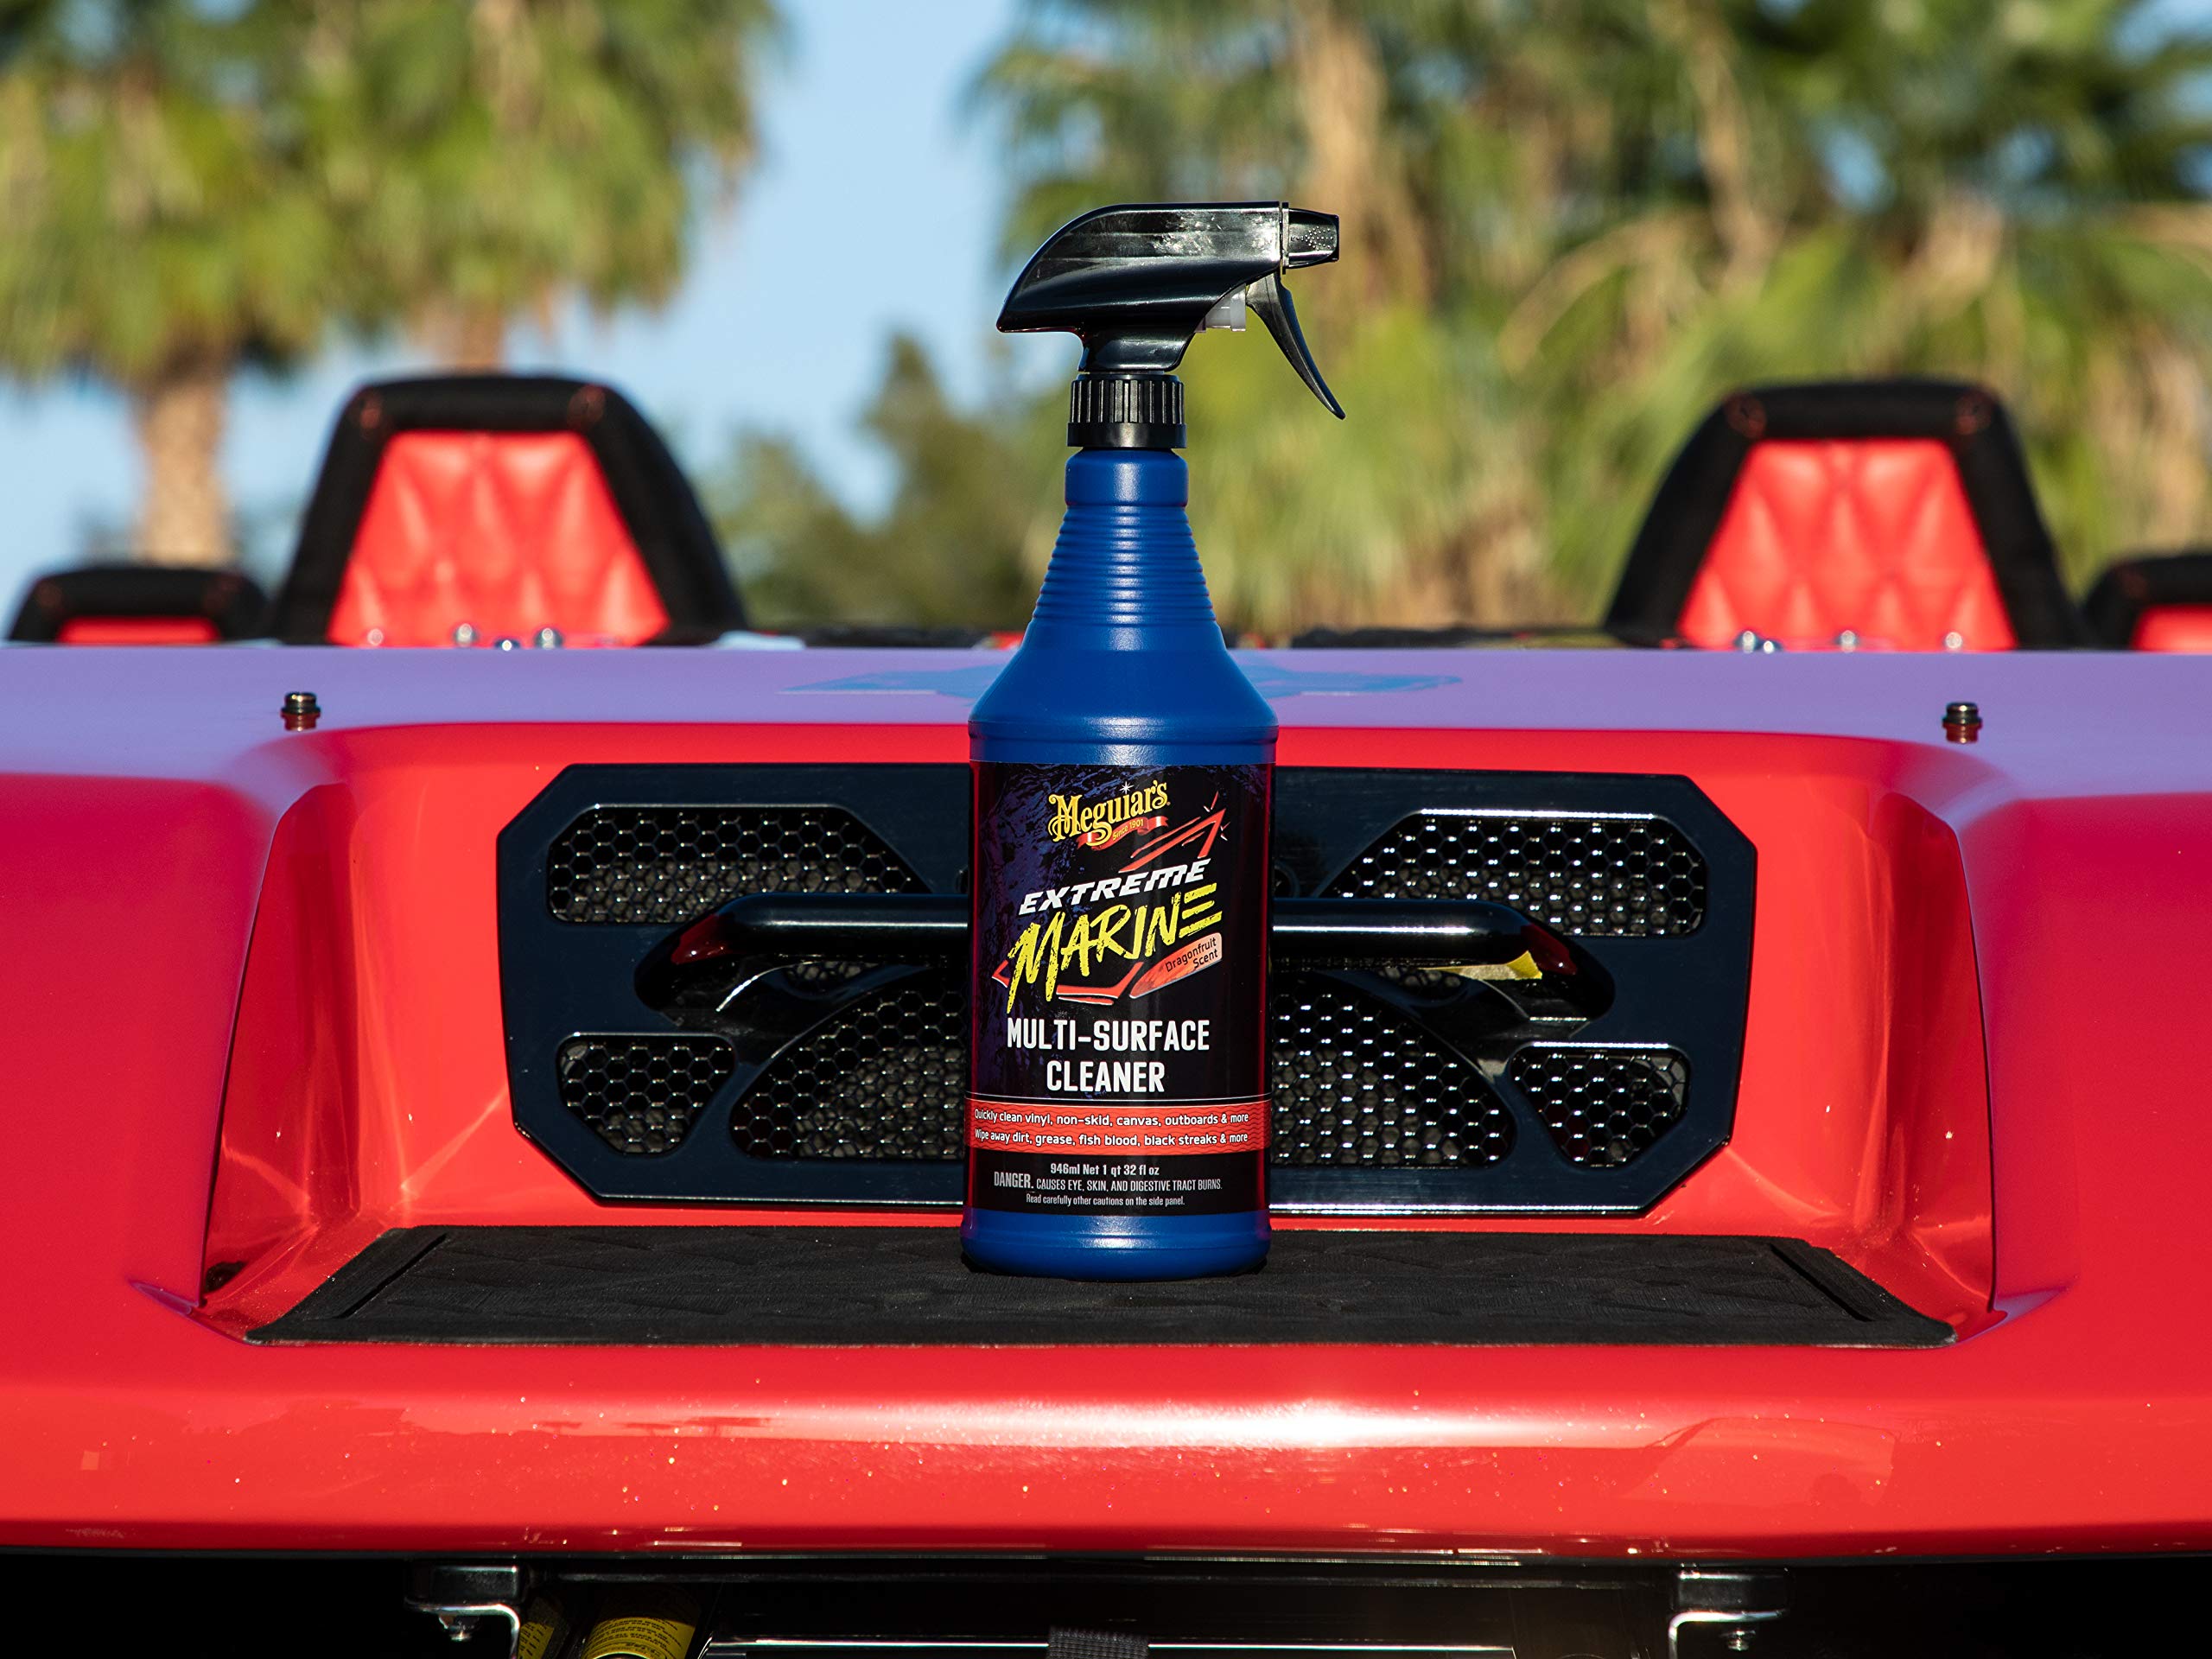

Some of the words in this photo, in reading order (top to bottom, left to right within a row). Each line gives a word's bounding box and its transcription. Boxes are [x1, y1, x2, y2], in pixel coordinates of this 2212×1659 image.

[1047, 779, 1168, 847] Meguiar's
[1112, 826, 1128, 841] Since
[1128, 818, 1144, 831] 1901
[1018, 858, 1211, 916] EXTREME
[1007, 882, 1223, 1014] MARINE
[1165, 937, 1217, 972] Dragonfruit
[1192, 948, 1218, 969] Scent
[1007, 1017, 1210, 1051] MULTI-SURFACE
[1046, 1060, 1166, 1092] CLEANER
[974, 1108, 998, 1122] Quickly
[999, 1111, 1022, 1122] clean
[1025, 1112, 1053, 1127] vinyl,
[1056, 1115, 1113, 1127] non-skid,
[1116, 1116, 1162, 1127] canvas,
[1165, 1114, 1218, 1125] outboards
[1220, 1113, 1227, 1123] &
[1230, 1113, 1249, 1122] more
[975, 1128, 989, 1141] Wipe
[990, 1131, 1010, 1144] away
[1012, 1132, 1033, 1144] dirt,
[1035, 1135, 1076, 1146] grease,
[1078, 1134, 1101, 1146] fish
[1104, 1135, 1141, 1147] blood,
[1144, 1135, 1176, 1146] black
[1178, 1134, 1217, 1145] streaks
[1219, 1133, 1227, 1143] &
[1229, 1133, 1249, 1143] more
[1050, 1162, 1080, 1175] 946ml
[1083, 1164, 1099, 1175] Net
[1103, 1164, 1107, 1175] 1
[1110, 1165, 1122, 1177] qt
[1123, 1164, 1136, 1175] 32
[1139, 1164, 1147, 1175] fl
[1148, 1166, 1160, 1175] oz
[994, 1171, 1034, 1189] DANGER.
[1037, 1178, 1066, 1191] CAUSES
[1068, 1179, 1084, 1192] EYE,
[1087, 1179, 1109, 1192] SKIN,
[1111, 1180, 1128, 1192] AND
[1130, 1179, 1171, 1192] DIGESTIVE
[1173, 1179, 1197, 1191] TRACT
[1198, 1178, 1222, 1191] BURNS.
[1026, 1192, 1042, 1204] Read
[1043, 1194, 1071, 1207] carefully
[1073, 1196, 1091, 1205] other
[1093, 1197, 1123, 1206] cautions
[1135, 1196, 1147, 1205] the
[1148, 1196, 1164, 1205] side
[1165, 1196, 1185, 1207] panel.
